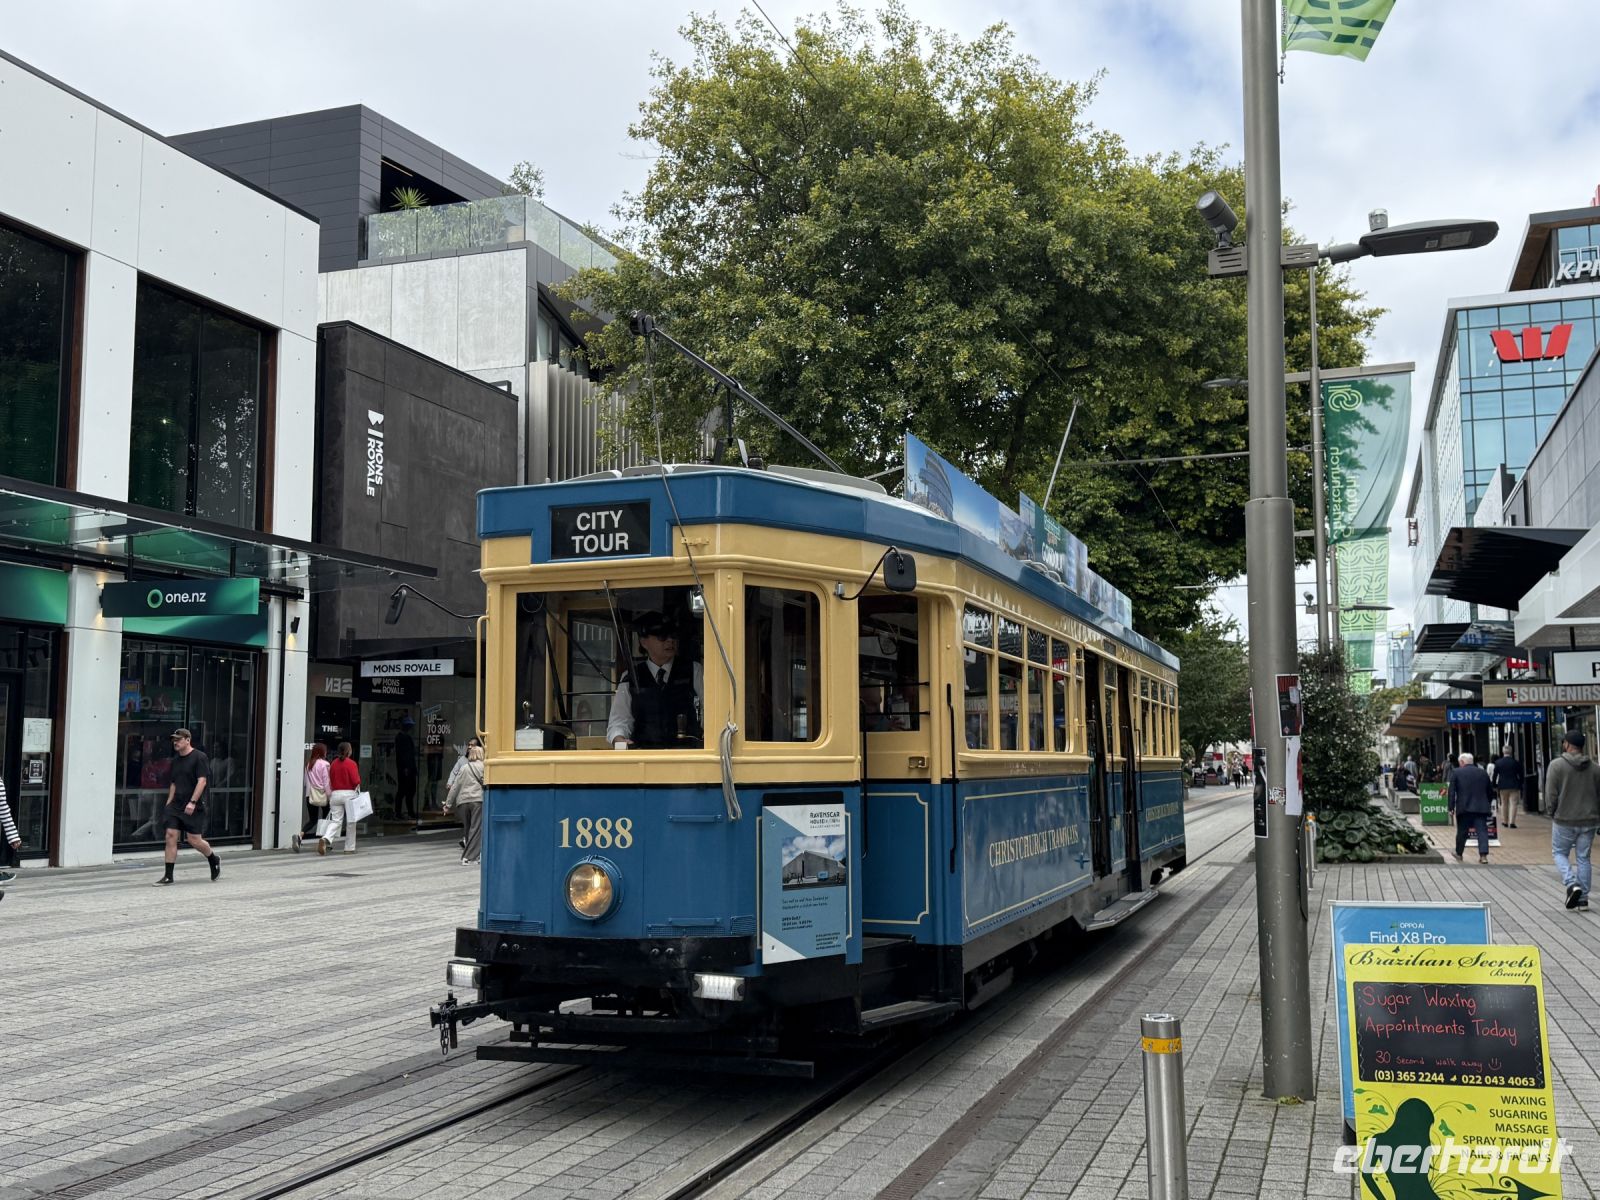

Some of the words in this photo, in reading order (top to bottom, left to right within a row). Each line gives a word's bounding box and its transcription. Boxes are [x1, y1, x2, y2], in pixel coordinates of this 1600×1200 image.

[366, 437, 376, 497] ROYALE
[375, 439, 384, 485] MONS
[576, 510, 623, 531] CITY
[571, 532, 629, 553] TOUR
[165, 592, 206, 603] one.nz
[1392, 640, 1407, 650] EY
[373, 664, 401, 673] MONS
[404, 663, 441, 672] ROYALE
[382, 678, 400, 686] MONS
[382, 686, 405, 694] ROYALE
[1519, 687, 1600, 702] SOUVENIRS
[1450, 712, 1480, 720] LSNZ
[322, 725, 338, 733] THE
[427, 724, 436, 734] TO
[437, 724, 451, 734] 30%
[558, 817, 633, 849] 1888
[989, 832, 1048, 868] CHRISTCHURCH
[1047, 824, 1079, 852] TRAMWAYS
[1370, 931, 1398, 943] Find
[1401, 931, 1420, 943] X8
[1424, 931, 1446, 944] Pro
[1350, 948, 1453, 967] Brazilian
[1458, 951, 1535, 969] Secrets
[1490, 968, 1533, 983] Beauty
[1361, 986, 1412, 1015] Sugar
[1423, 988, 1477, 1016] Waxing
[1365, 1016, 1465, 1039] Appointments
[1471, 1018, 1517, 1047] Today
[1375, 1050, 1391, 1064] 30
[1436, 1057, 1457, 1067] walk
[1461, 1061, 1483, 1073] away
[1374, 1071, 1394, 1082] (03)
[1397, 1071, 1416, 1081] 365
[1418, 1071, 1445, 1083] 2244
[1461, 1075, 1483, 1084] 022
[1484, 1075, 1505, 1085] 043
[1507, 1076, 1536, 1087] 4063
[1500, 1095, 1546, 1106] WAXING
[1489, 1108, 1548, 1120] SUGARING
[1495, 1123, 1549, 1134] MASSAGE
[1463, 1135, 1496, 1145] SPRAY
[1498, 1137, 1550, 1148] TANNING
[1461, 1150, 1494, 1160] NAILS
[1496, 1150, 1504, 1160] &
[1506, 1151, 1551, 1163] FACIALS
